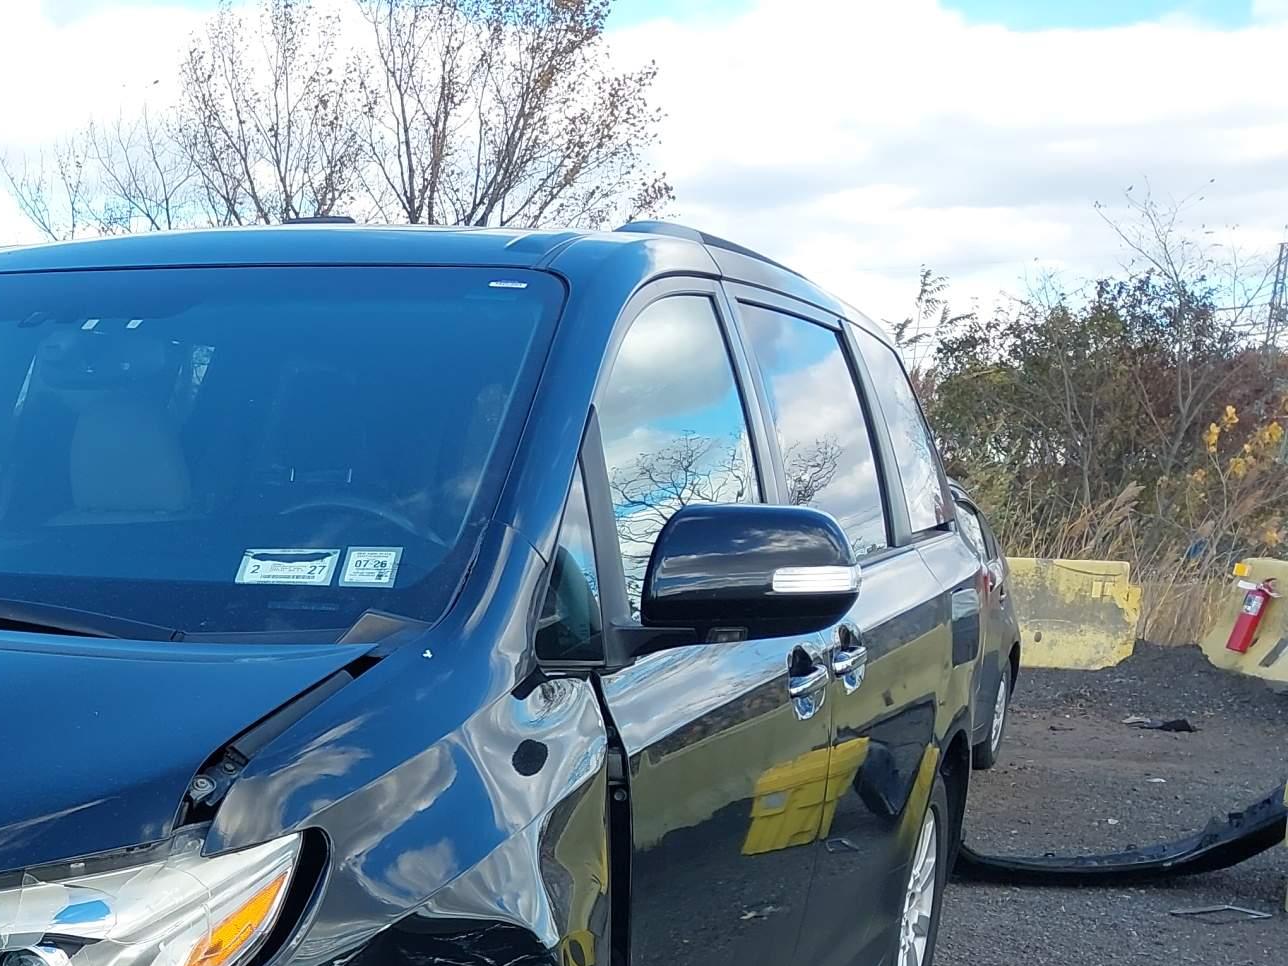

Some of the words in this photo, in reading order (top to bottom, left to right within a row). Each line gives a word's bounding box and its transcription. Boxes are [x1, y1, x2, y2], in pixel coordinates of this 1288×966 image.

[354, 560, 369, 568] 07
[373, 560, 388, 568] 26
[249, 564, 261, 574] 2
[307, 565, 327, 575] 27
